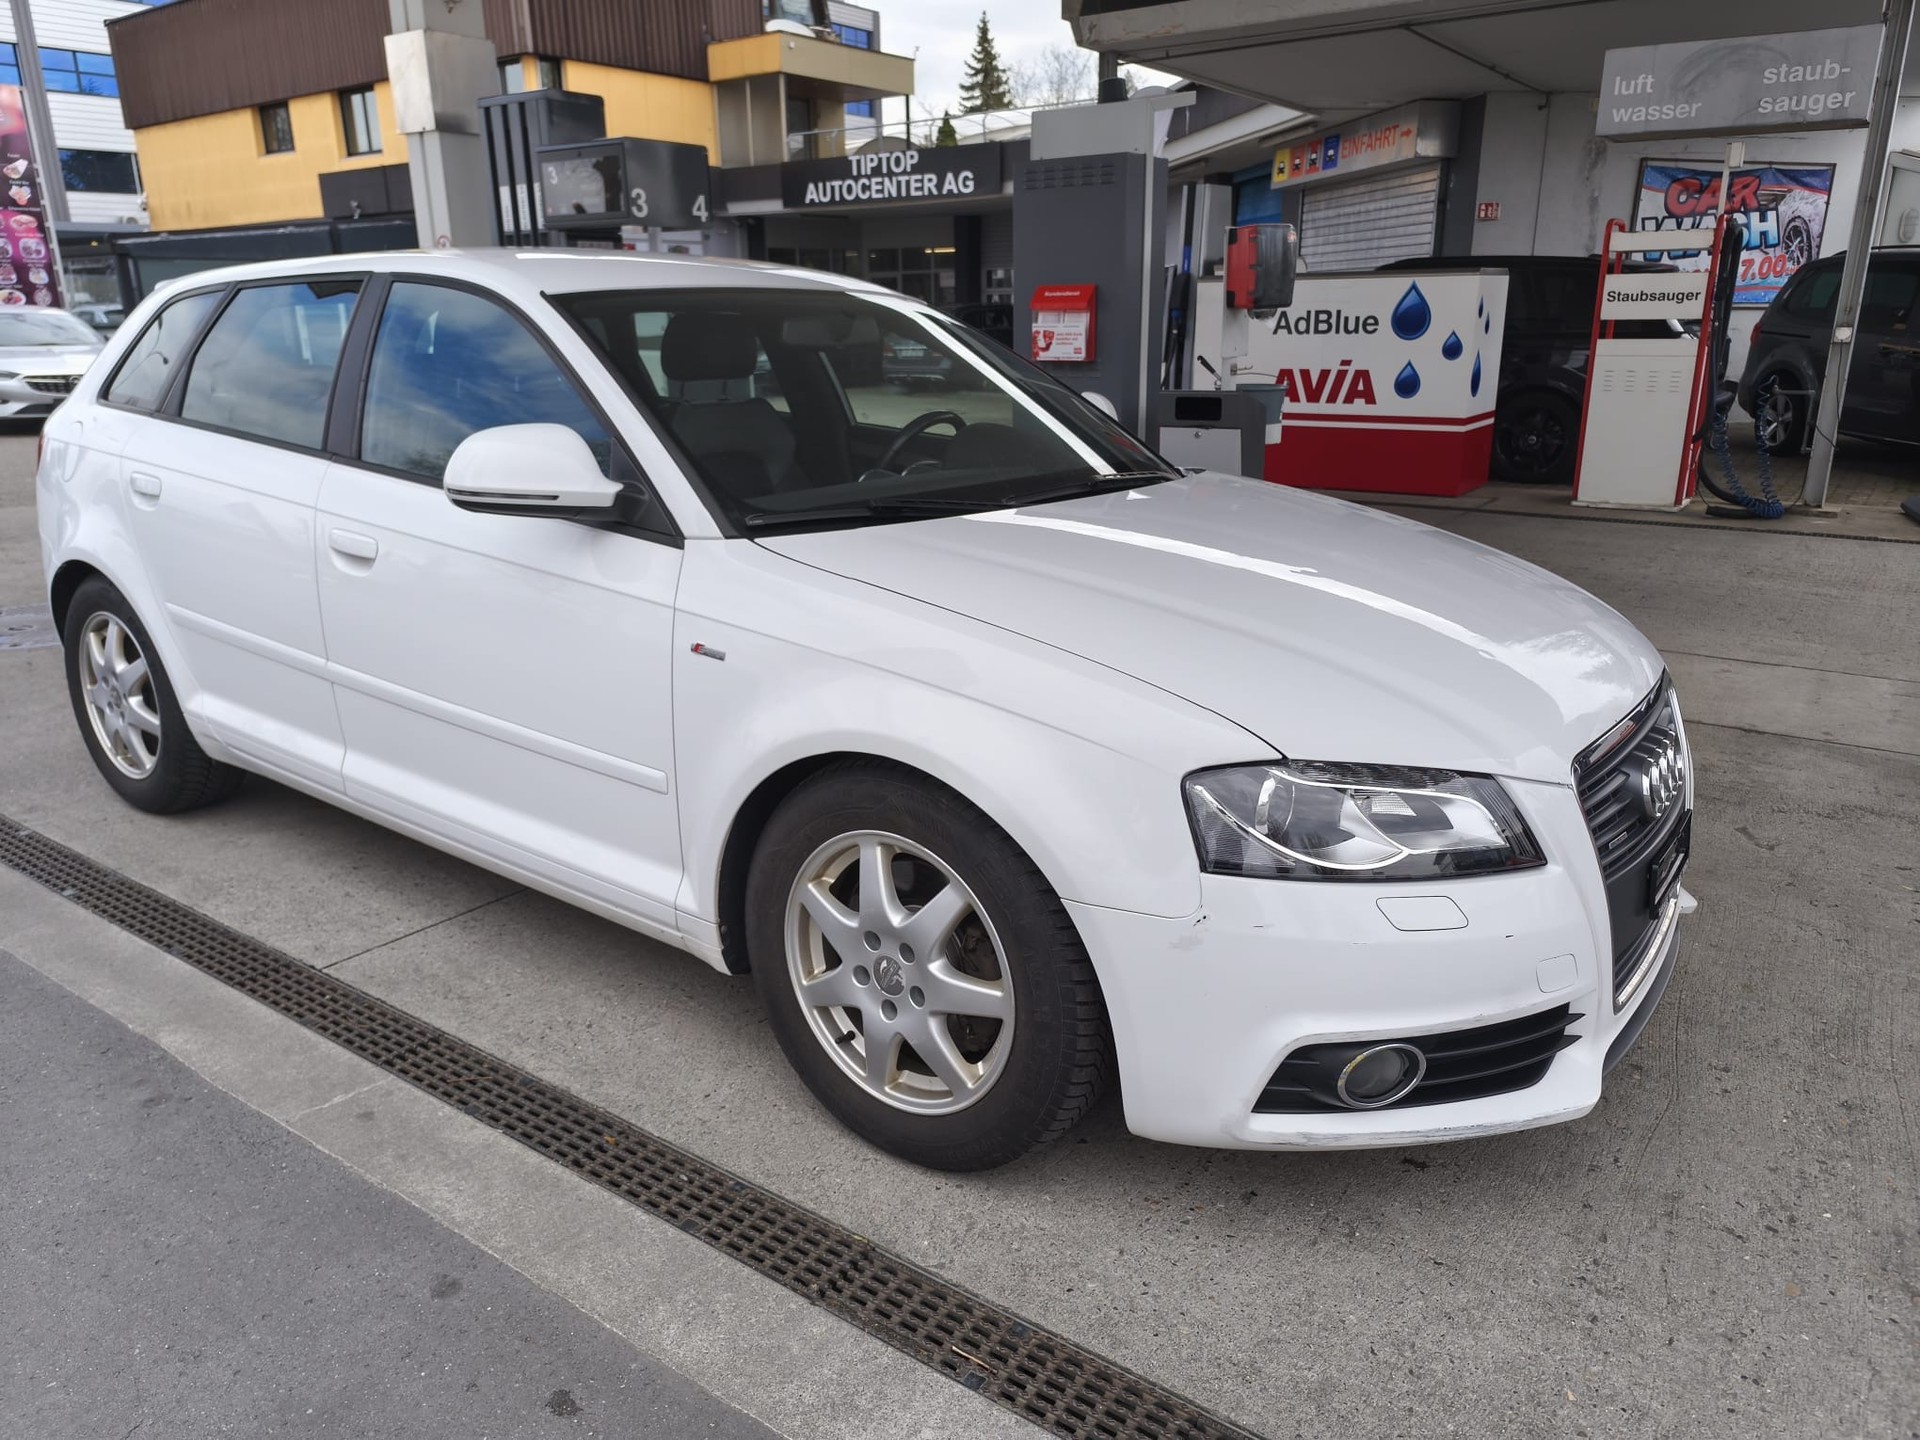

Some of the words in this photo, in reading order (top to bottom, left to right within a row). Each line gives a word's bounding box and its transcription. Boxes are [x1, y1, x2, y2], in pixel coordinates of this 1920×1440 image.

[1763, 59, 1851, 84] staub-
[1613, 74, 1655, 97] luft
[1612, 101, 1702, 124] wasser
[1757, 91, 1856, 117] sauger
[1341, 125, 1399, 159] EINFAHRT
[849, 151, 920, 176] TIPTOP
[804, 177, 938, 204] AUTOCENTER
[943, 171, 975, 194] AG
[1665, 176, 1761, 217] CAR
[631, 188, 649, 218] 3
[692, 195, 709, 222] 4
[1741, 254, 1788, 281] 7.00
[1607, 290, 1701, 304] Staubsauger
[1272, 310, 1379, 335] AdBlue
